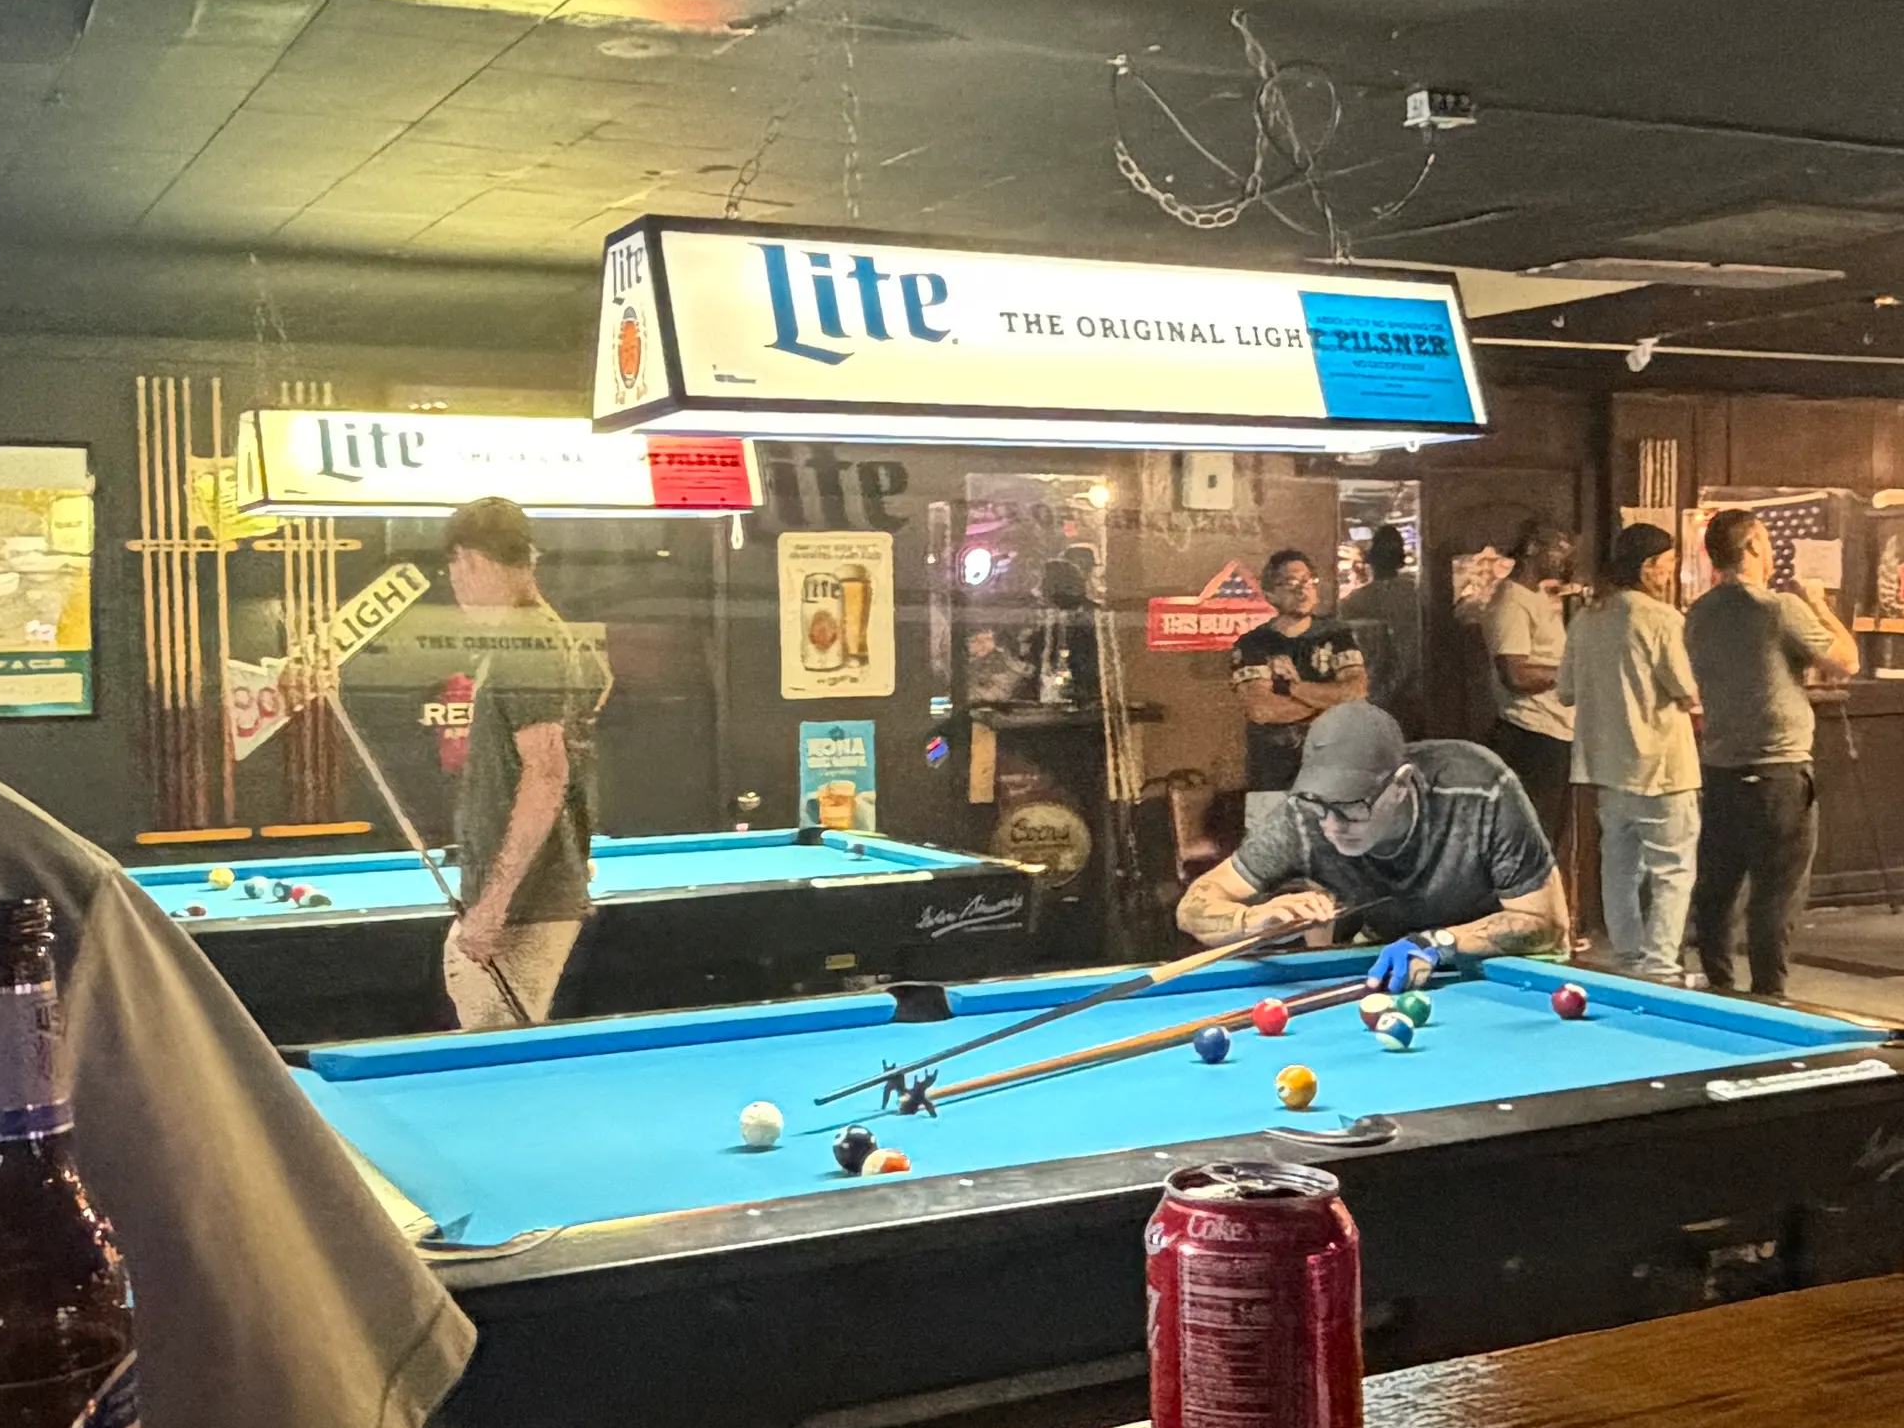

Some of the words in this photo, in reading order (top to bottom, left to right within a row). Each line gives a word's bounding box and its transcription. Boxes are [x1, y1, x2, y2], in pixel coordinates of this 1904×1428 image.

[611, 244, 645, 306] Lite
[748, 242, 950, 365] Lite
[999, 310, 1065, 338] THE
[1076, 315, 1225, 347] ORIGINAL
[1234, 324, 1335, 353] LIGHT
[1336, 329, 1450, 357] PILSNER
[317, 418, 425, 483] Lite
[768, 441, 909, 531] ite
[330, 565, 426, 653] LIGHT
[1186, 1214, 1248, 1242] Coke
